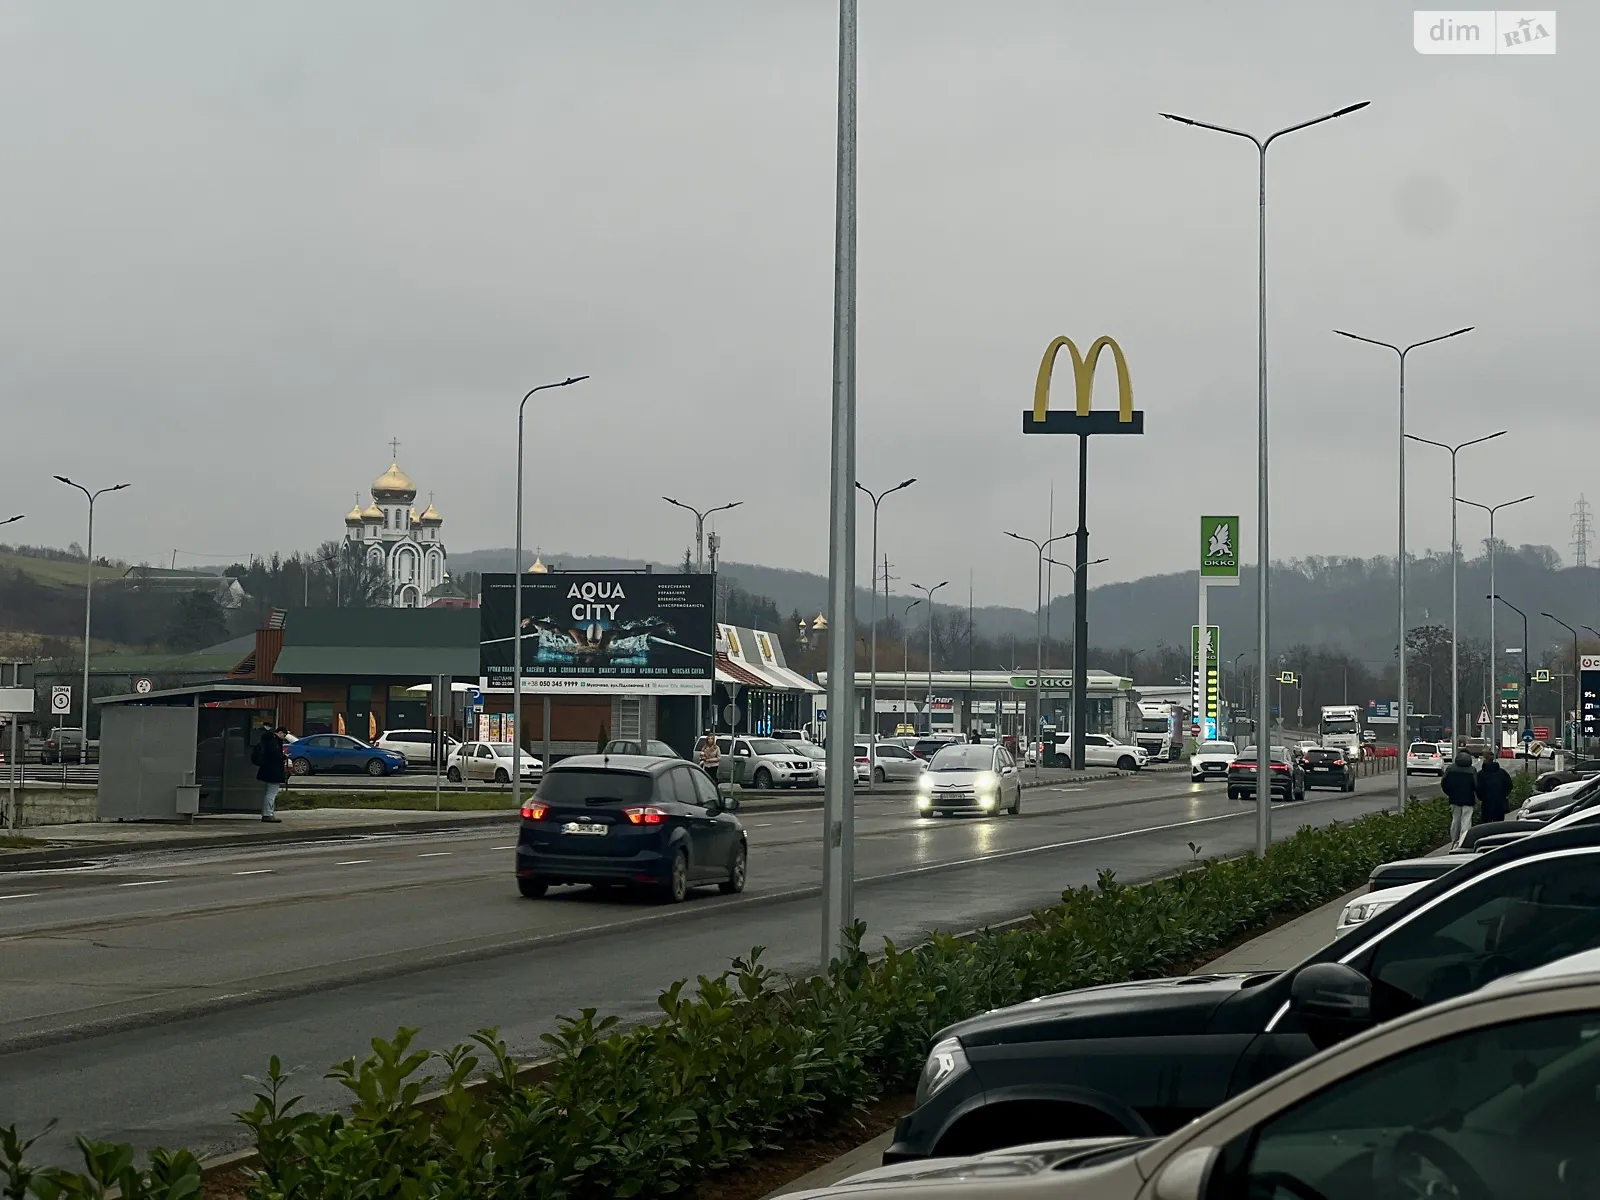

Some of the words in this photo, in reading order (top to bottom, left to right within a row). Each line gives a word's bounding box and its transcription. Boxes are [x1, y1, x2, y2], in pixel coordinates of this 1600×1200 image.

[566, 582, 626, 603] AQUA
[571, 603, 620, 621] CITY
[526, 665, 545, 673] БАСЕЙНИ
[892, 704, 898, 712] 2
